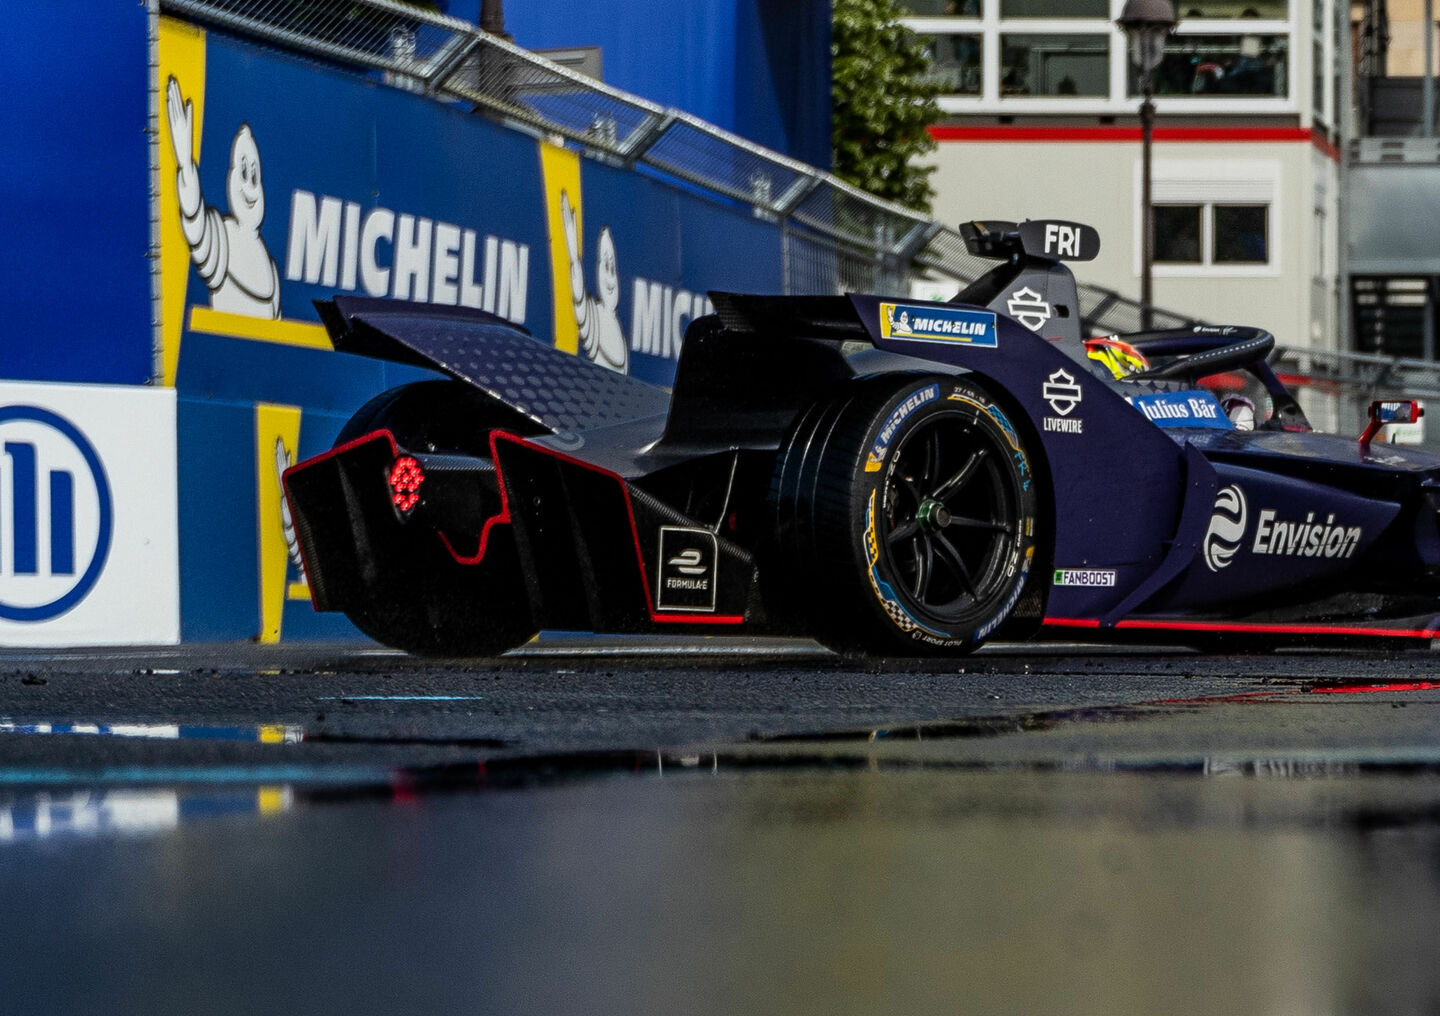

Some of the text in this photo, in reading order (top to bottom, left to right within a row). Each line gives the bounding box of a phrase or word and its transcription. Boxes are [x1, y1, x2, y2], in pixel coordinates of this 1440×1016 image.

[1044, 224, 1081, 257] FRI
[287, 189, 530, 324] MICHELIN
[913, 317, 986, 335] MICHELIN
[880, 388, 935, 444] MICHELIN
[1138, 399, 1217, 421] Julius Bär
[1043, 417, 1082, 434] LIVEWIRE
[1252, 509, 1362, 559] Envision
[1063, 571, 1114, 585] FANBOOST
